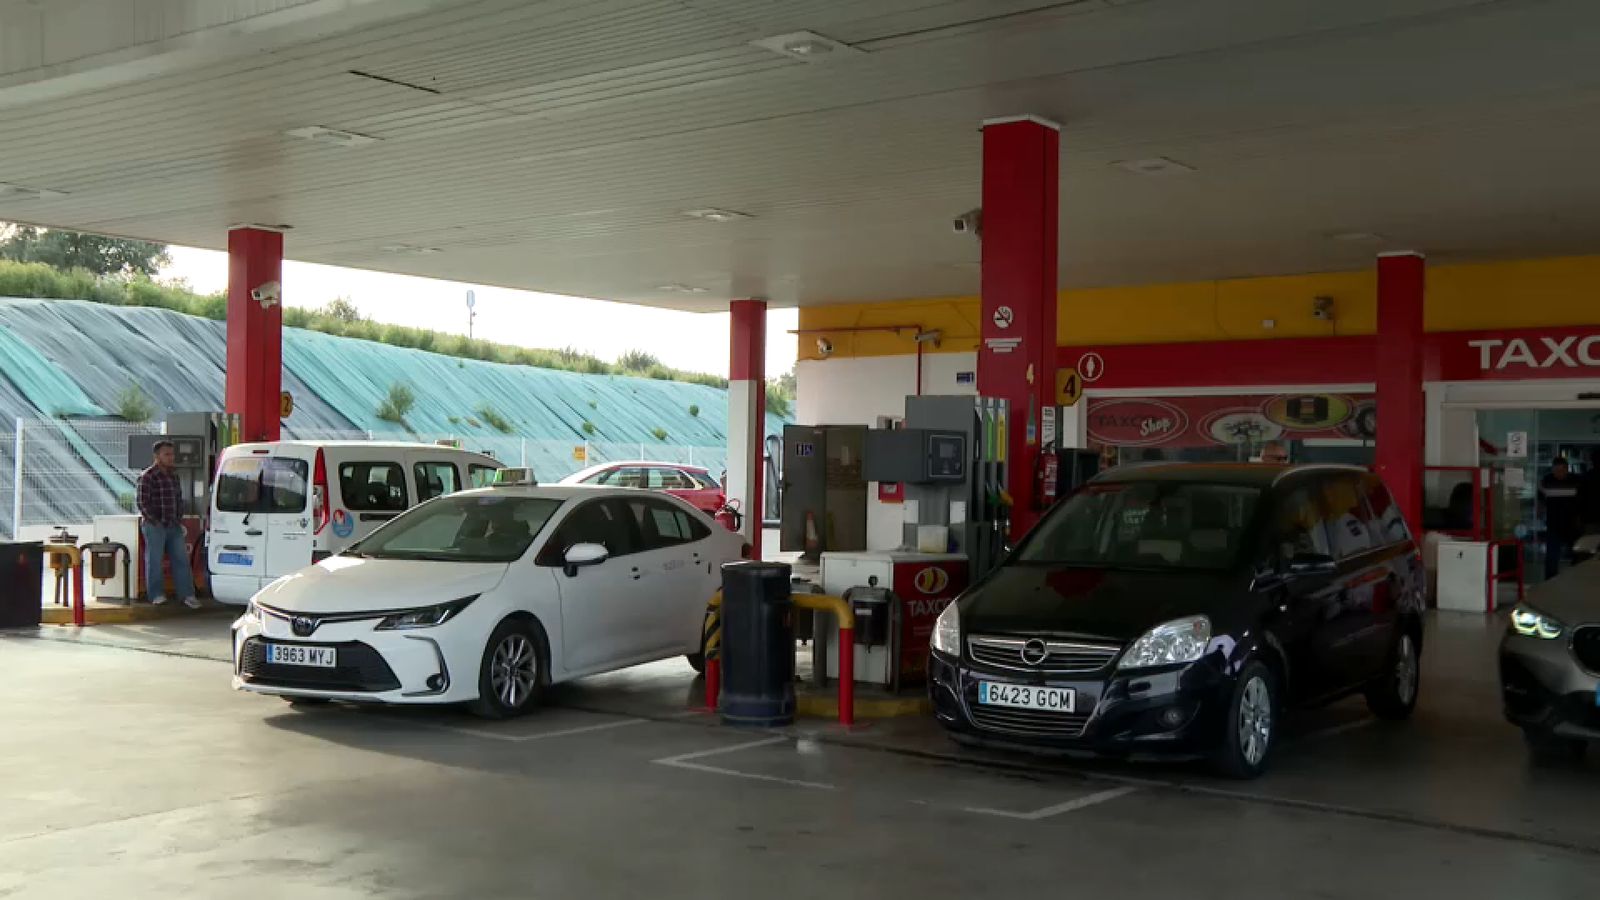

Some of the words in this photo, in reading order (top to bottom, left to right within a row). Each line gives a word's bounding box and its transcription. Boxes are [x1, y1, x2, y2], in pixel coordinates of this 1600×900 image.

[1026, 361, 1035, 385] 4
[1063, 374, 1076, 398] 4
[1140, 417, 1171, 437] Shop
[274, 646, 305, 662] 3963
[309, 649, 334, 665] MYJ
[989, 684, 1031, 705] 6423
[1036, 689, 1071, 709] GCM
